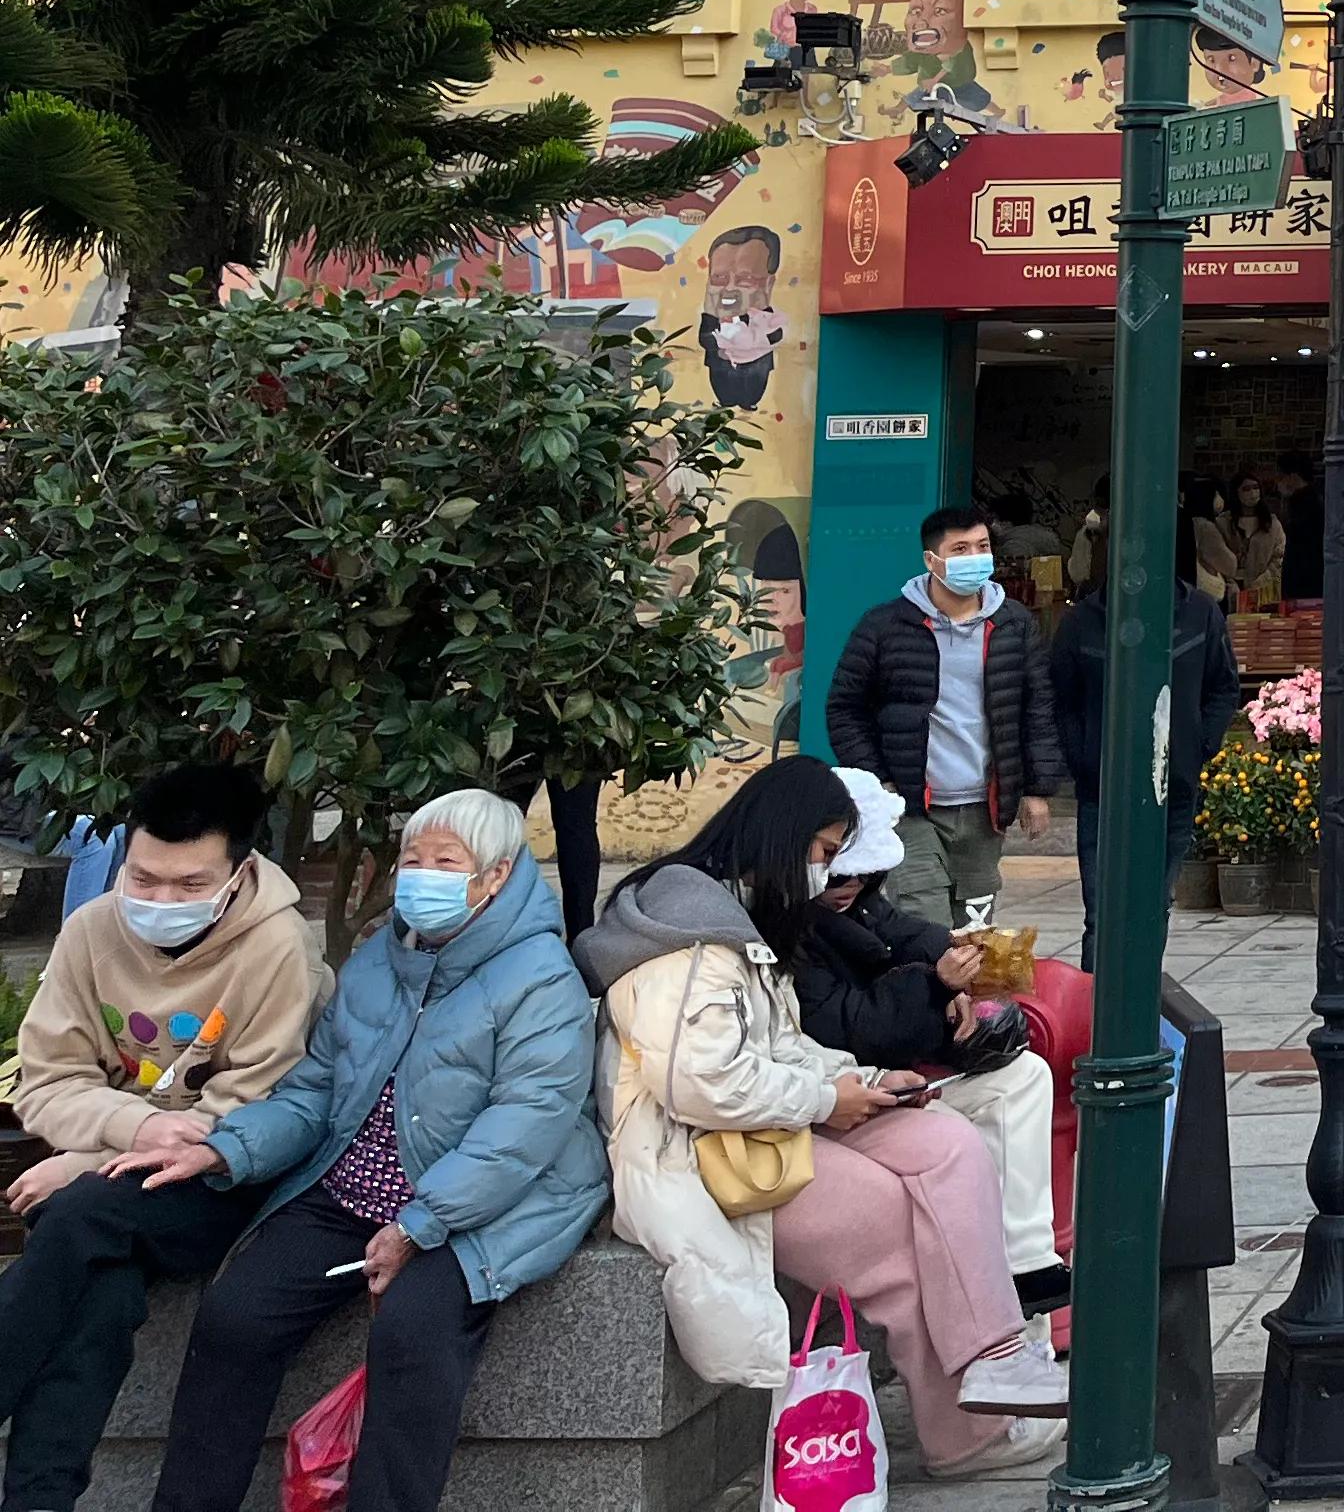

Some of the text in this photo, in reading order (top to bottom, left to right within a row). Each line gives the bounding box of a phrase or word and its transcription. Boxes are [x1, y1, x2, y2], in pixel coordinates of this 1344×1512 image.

[994, 199, 1032, 234] 澳門
[1022, 263, 1117, 279] CHOI HEONG
[1240, 264, 1295, 273] MACAU
[843, 270, 862, 285] Since
